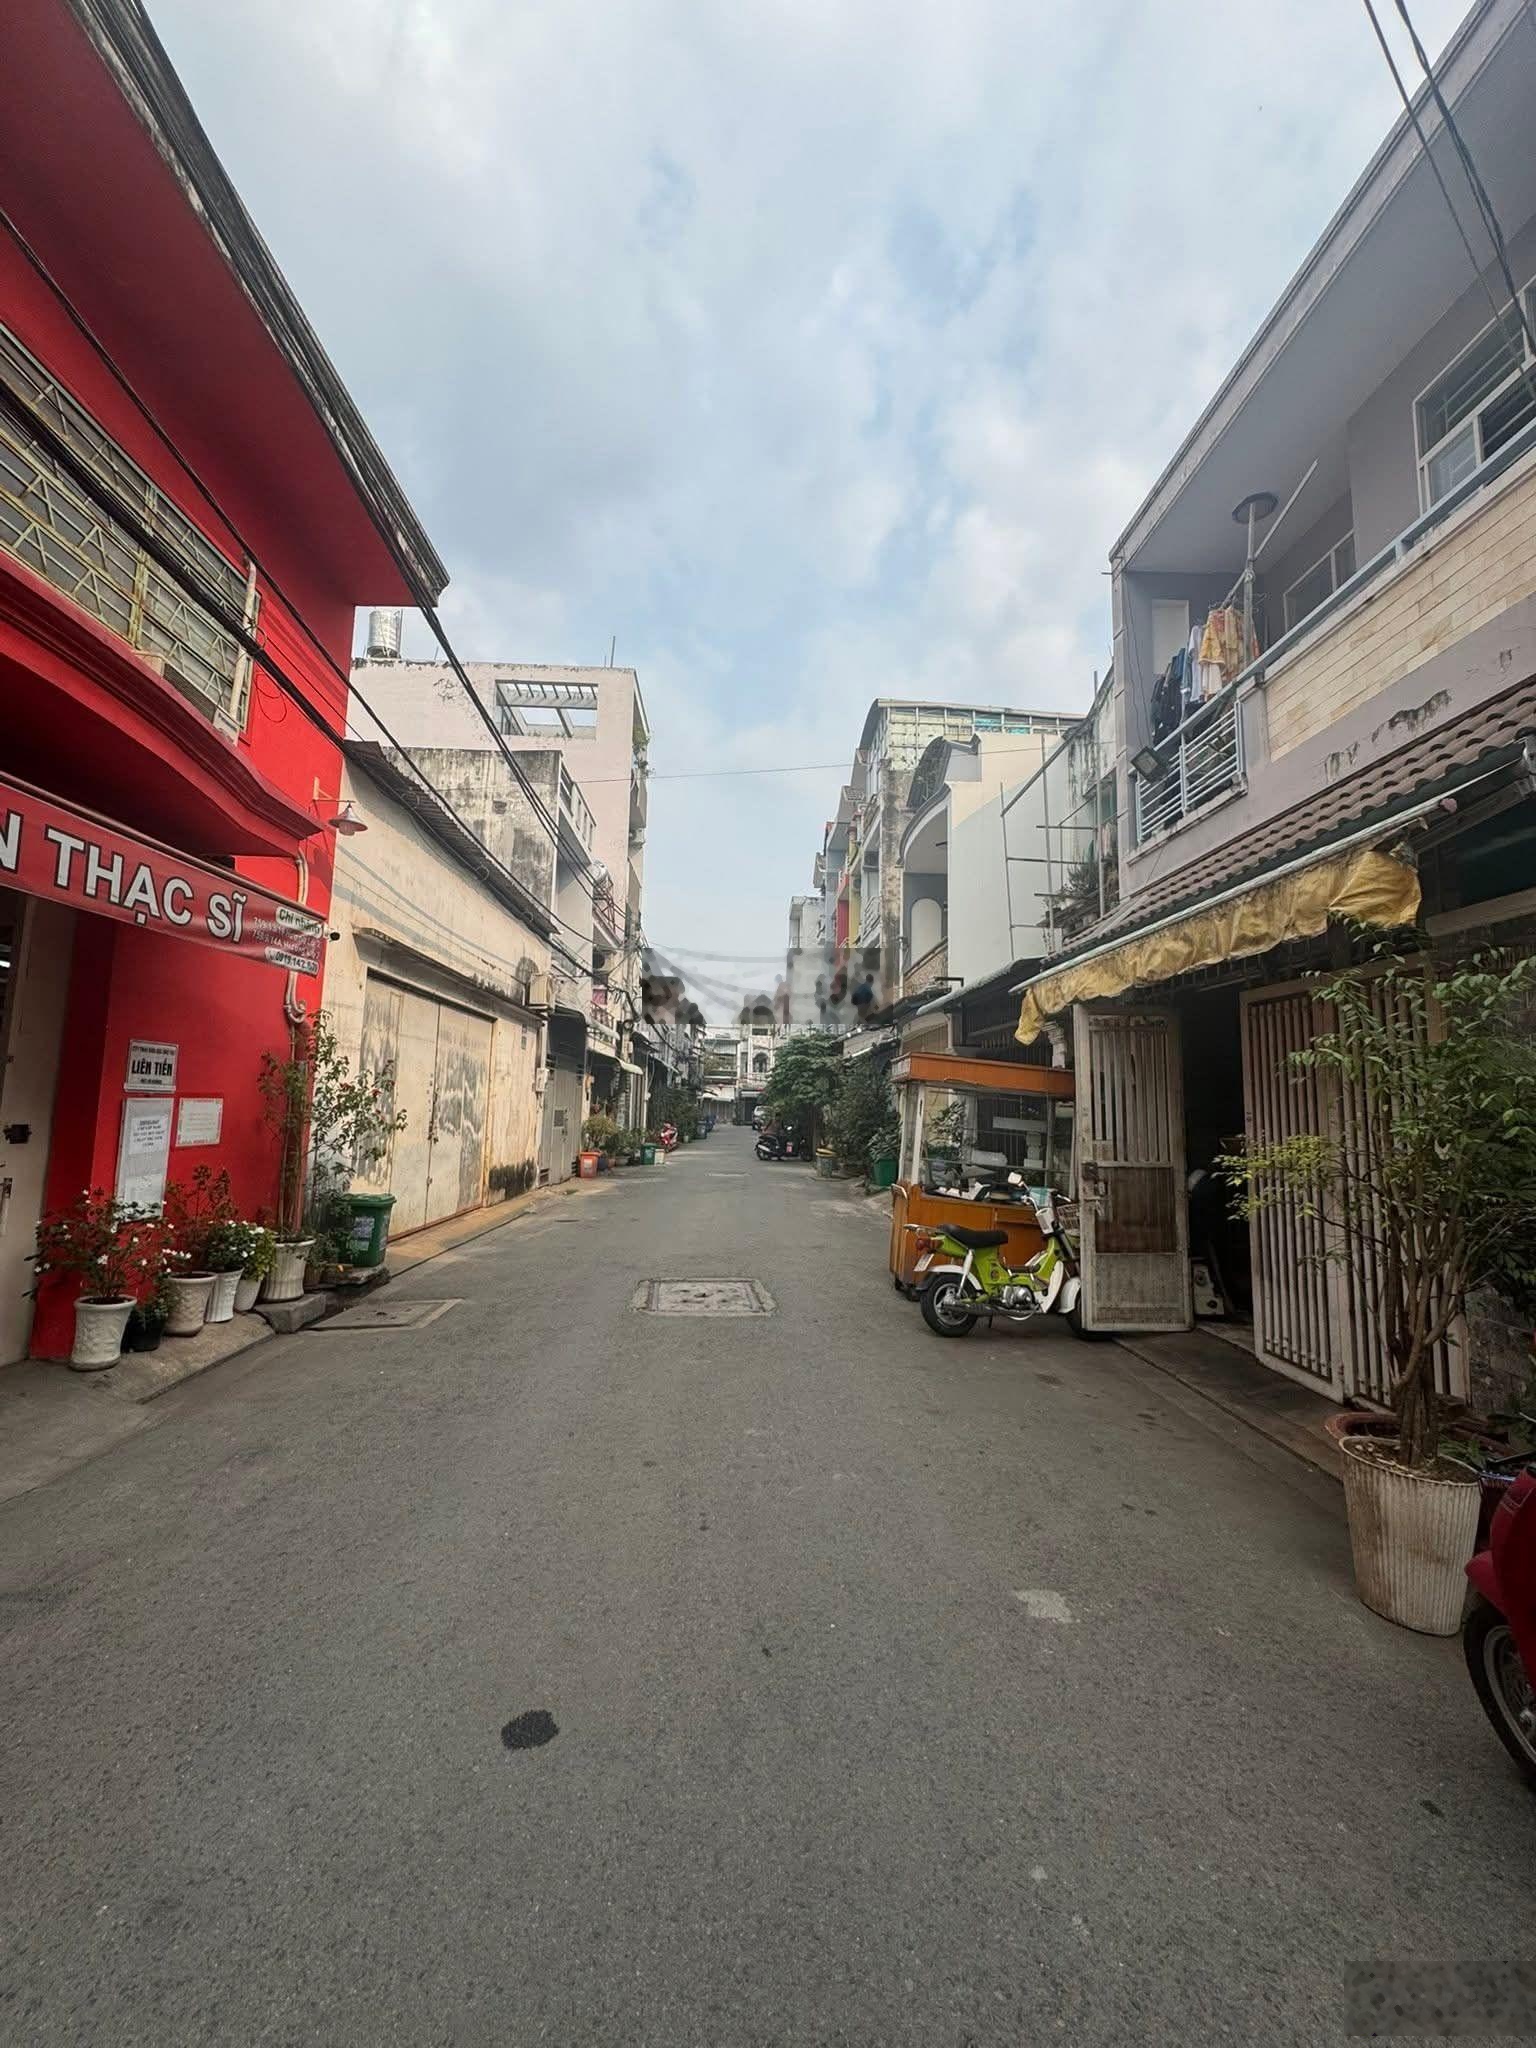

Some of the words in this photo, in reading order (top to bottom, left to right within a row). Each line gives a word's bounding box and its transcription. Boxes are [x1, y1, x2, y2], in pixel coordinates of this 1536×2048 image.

[46, 827, 193, 925] THẠC
[206, 891, 247, 943] SĨ
[131, 1058, 151, 1075] LIÊN
